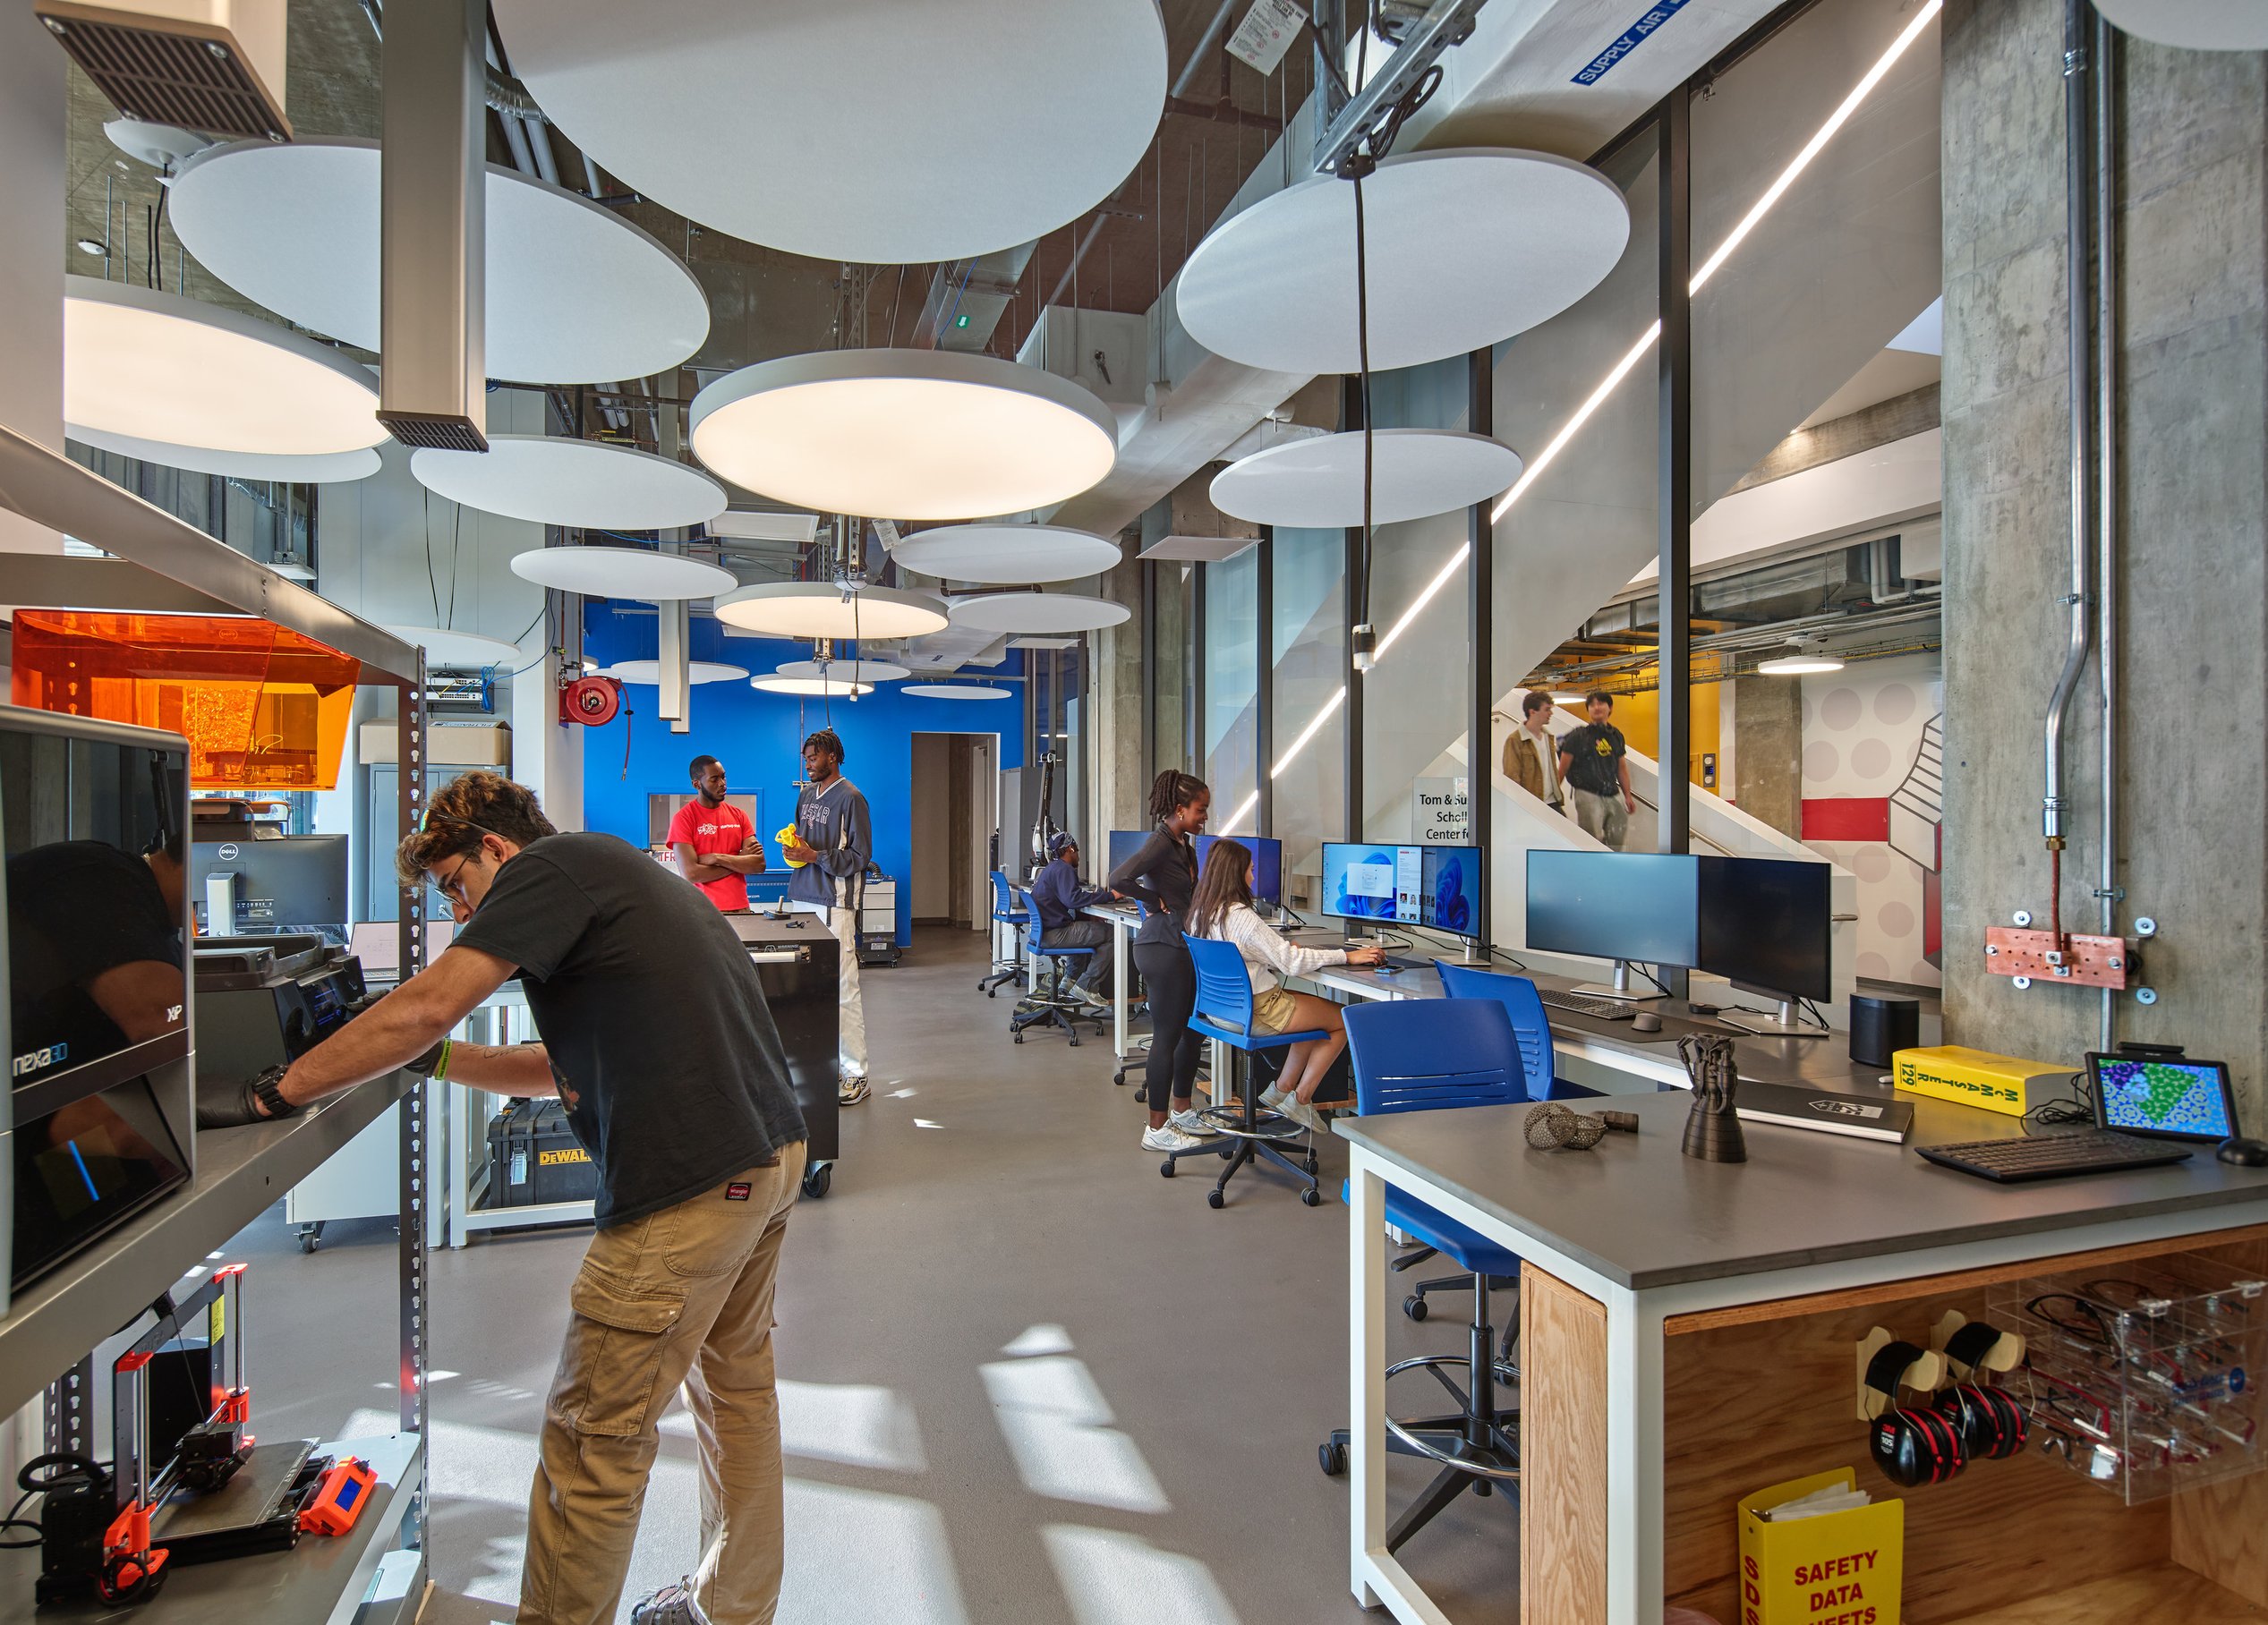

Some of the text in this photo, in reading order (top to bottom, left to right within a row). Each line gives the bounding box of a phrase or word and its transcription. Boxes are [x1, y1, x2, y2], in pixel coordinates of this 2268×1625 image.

[1579, 11, 1667, 81] SUPPLY AIR
[1420, 795, 1467, 804] Tom & Su
[1437, 812, 1467, 822] Scholl
[1427, 830, 1460, 839] Center
[1902, 1063, 1914, 1086] 129
[541, 1151, 591, 1164] DEWAL
[1882, 1424, 1896, 1434] 3M
[1880, 1436, 1894, 1447] 105
[1795, 1550, 1878, 1586] SAFETY
[1811, 1583, 1863, 1612] DATA
